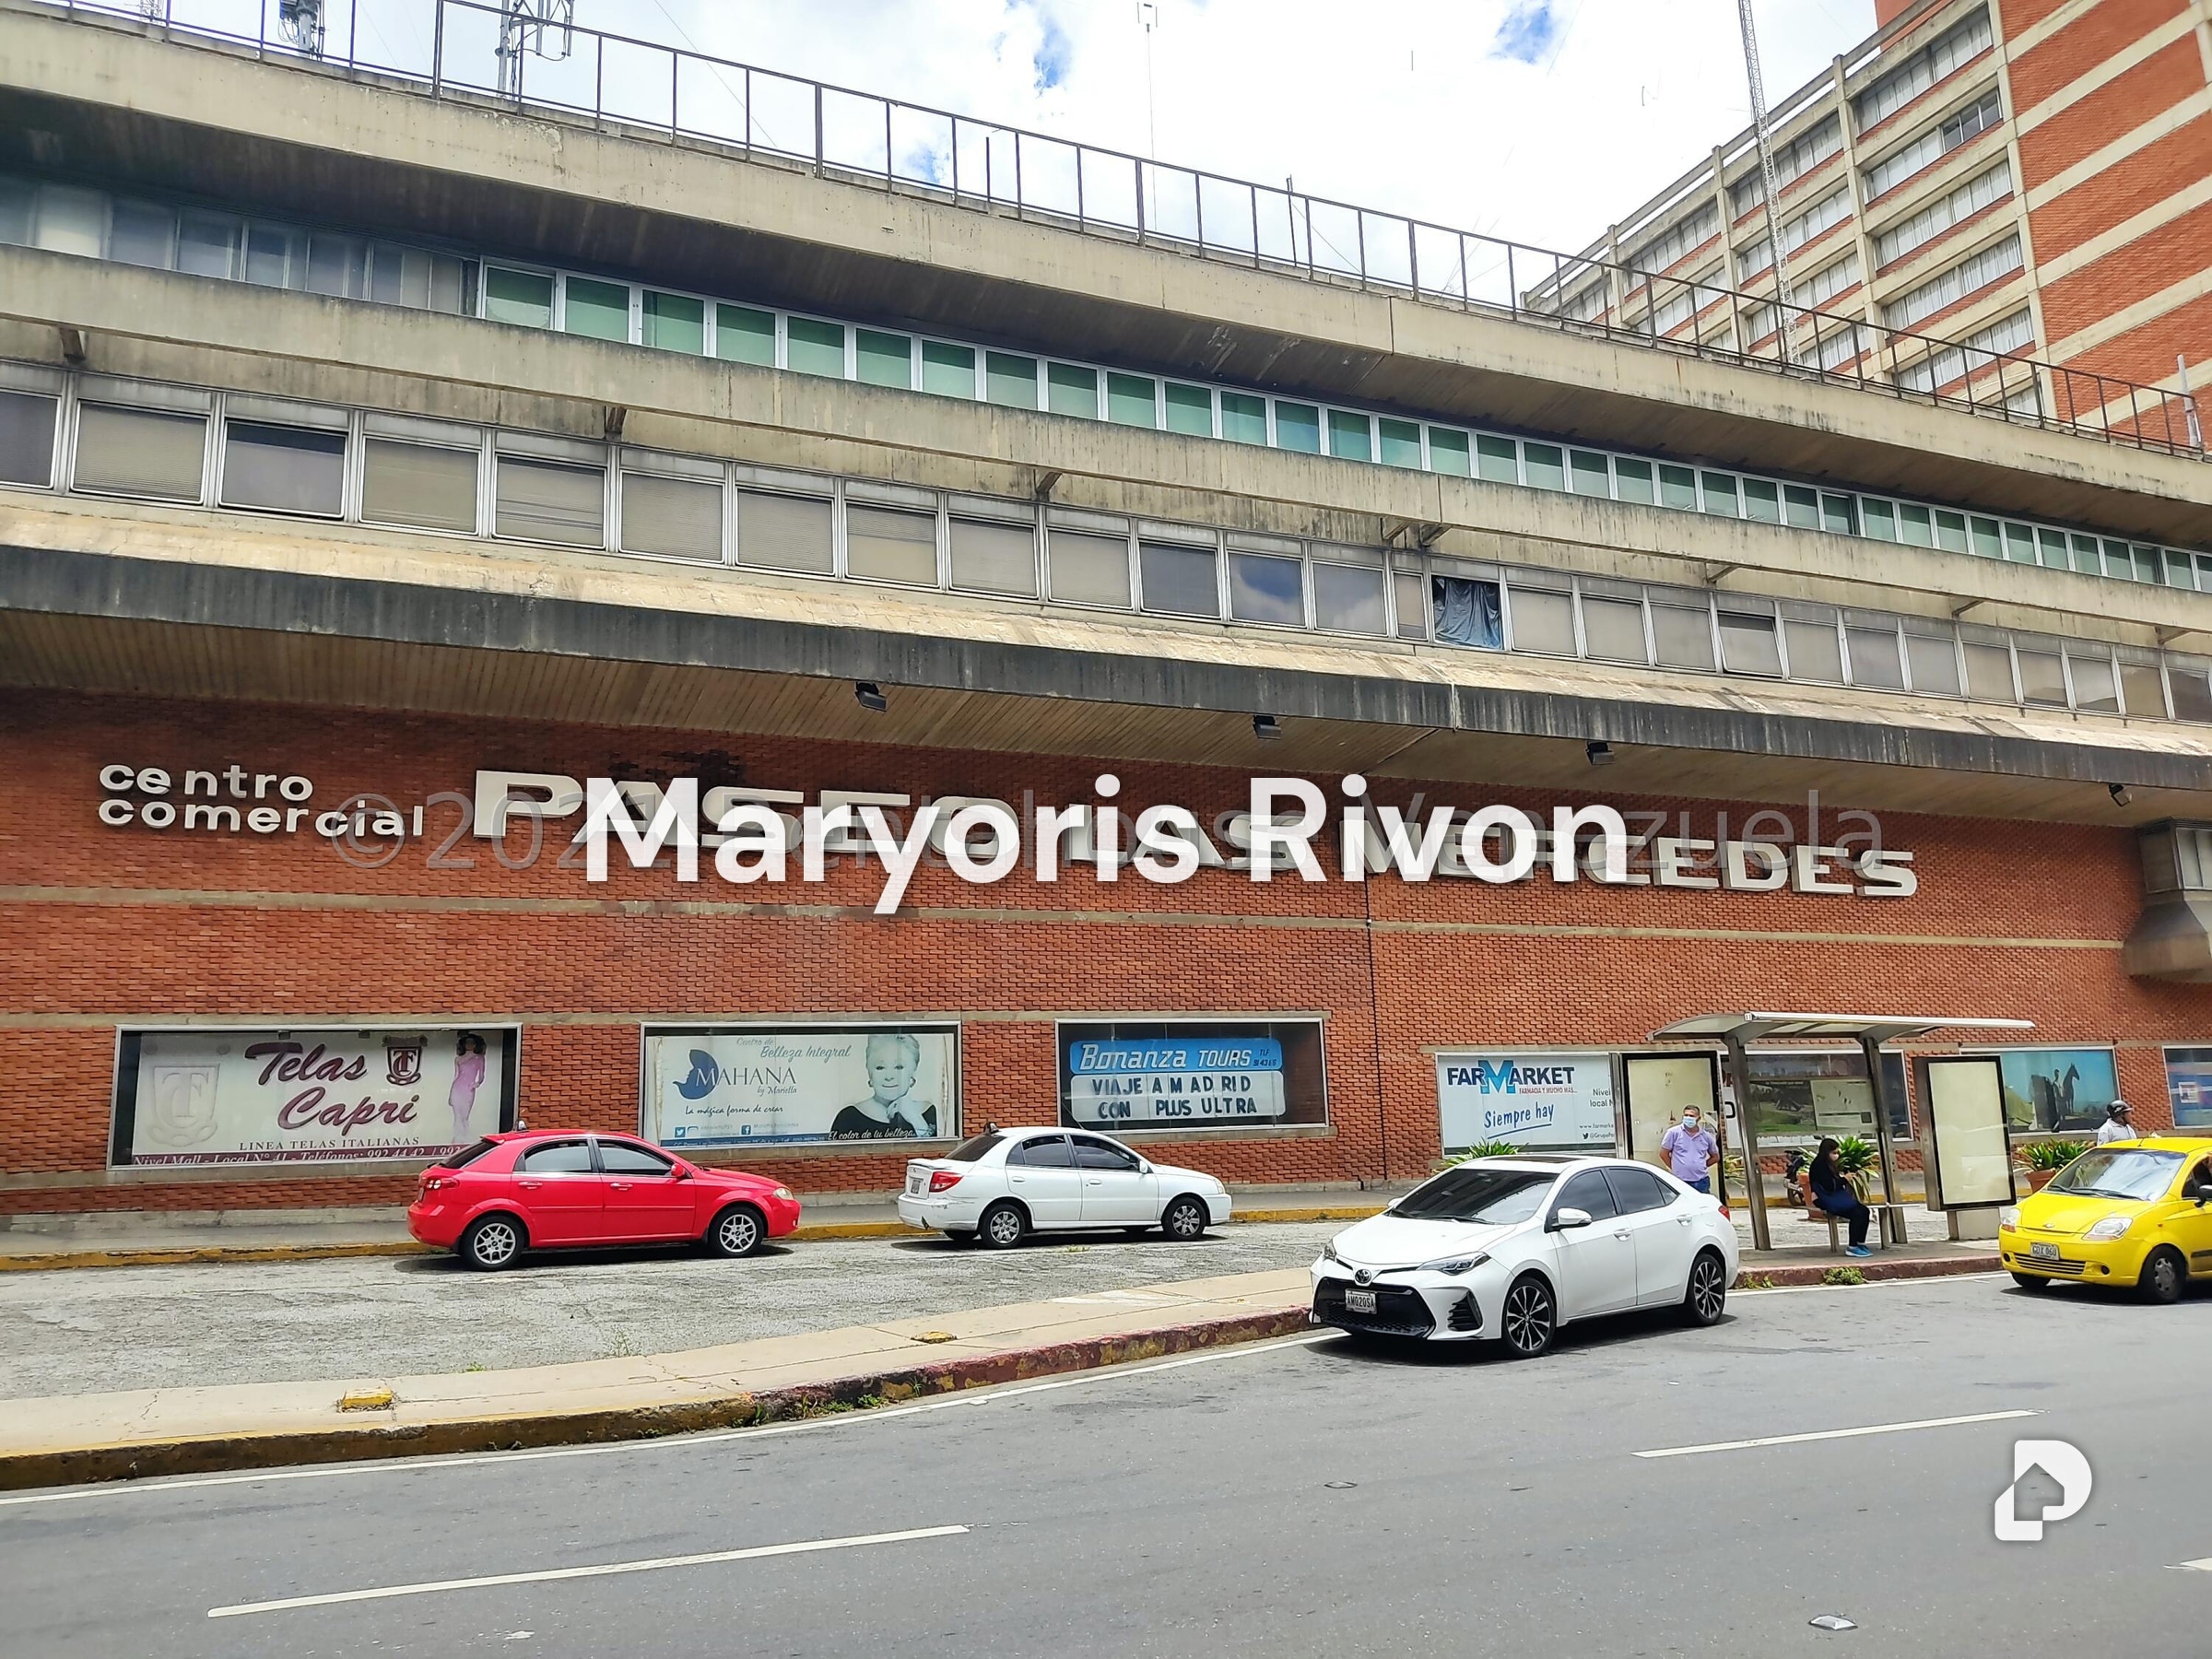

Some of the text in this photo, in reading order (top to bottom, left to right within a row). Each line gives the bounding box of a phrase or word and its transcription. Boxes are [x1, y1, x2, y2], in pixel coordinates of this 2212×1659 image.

[99, 764, 313, 801] centro
[98, 798, 424, 838] comercial
[1339, 819, 1918, 897] MERCEDES
[244, 1041, 368, 1086] Telas
[760, 1044, 853, 1064] Belleza Integral
[1079, 1043, 1253, 1071] Bonanza TOURS
[695, 1066, 797, 1087] MAHANA
[1092, 1077, 1143, 1096] VIAJE
[277, 1086, 420, 1136] Capri
[1099, 1097, 1257, 1119] CON PLUS ULTRA
[1484, 1100, 1554, 1129] Siempre hay
[1590, 1099, 1607, 1107] local
[239, 1136, 420, 1151] LINEA TELAS ITALIANAS
[838, 1129, 860, 1140] color
[861, 1128, 873, 1139] de
